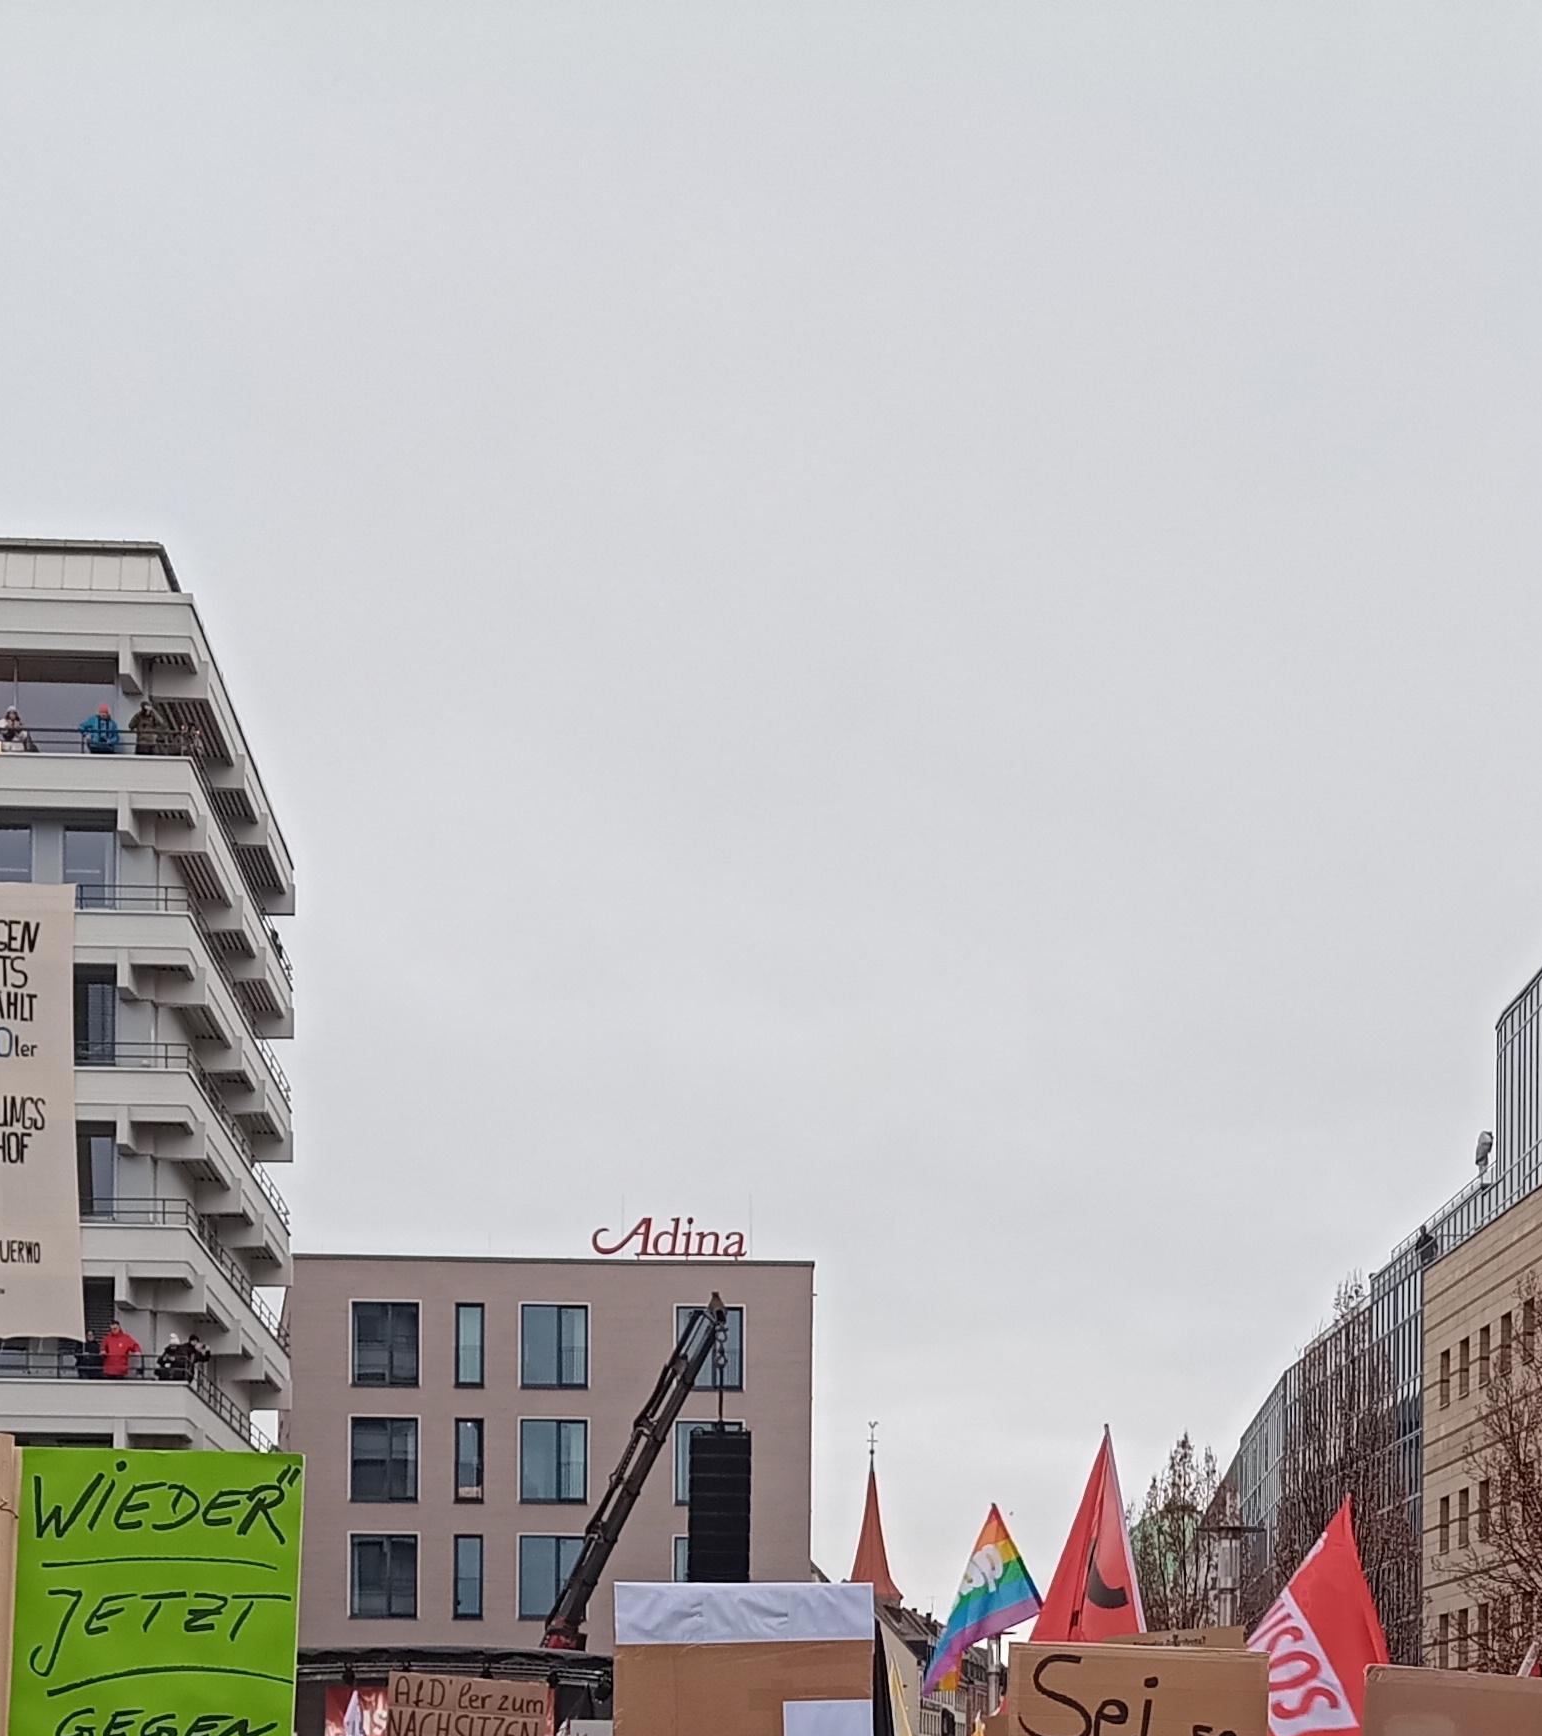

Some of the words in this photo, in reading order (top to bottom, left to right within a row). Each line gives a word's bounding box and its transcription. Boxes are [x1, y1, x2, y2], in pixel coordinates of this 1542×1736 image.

[591, 1216, 747, 1257] Adina
[30, 1588, 292, 1677] JETZT
[497, 1694, 545, 1715] zum
